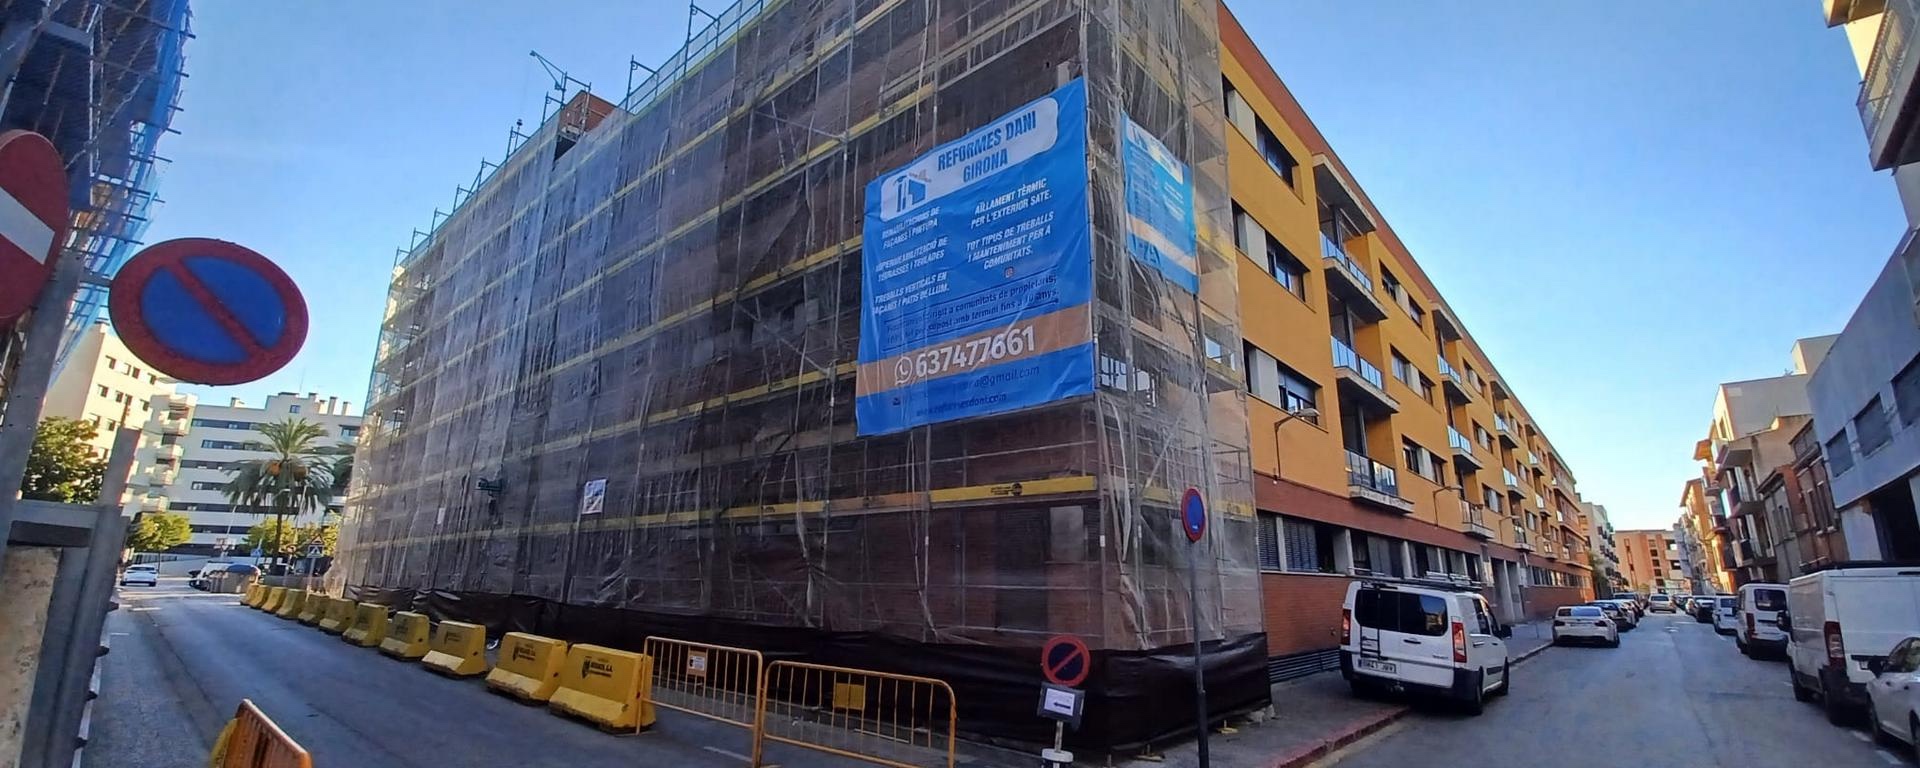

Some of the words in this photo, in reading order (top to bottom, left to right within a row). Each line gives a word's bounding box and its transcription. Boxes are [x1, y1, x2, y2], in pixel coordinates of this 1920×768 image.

[938, 129, 1002, 171] REFORMES
[1005, 111, 1036, 141] DANI
[963, 148, 1008, 183] GIRONA
[1017, 178, 1047, 198] TÈRMIC
[930, 207, 940, 216] DE
[971, 216, 987, 229] PER
[986, 199, 1029, 223] L'EXTERIOR
[967, 240, 980, 252] TOT
[982, 232, 1003, 246] TIPUS
[1003, 227, 1015, 238] DE
[1016, 211, 1054, 234] TREBALLS
[1028, 228, 1044, 241] PER
[937, 237, 948, 248] DE
[937, 271, 948, 281] EN
[955, 294, 997, 312] comunitats
[916, 325, 1035, 377] 637477661
